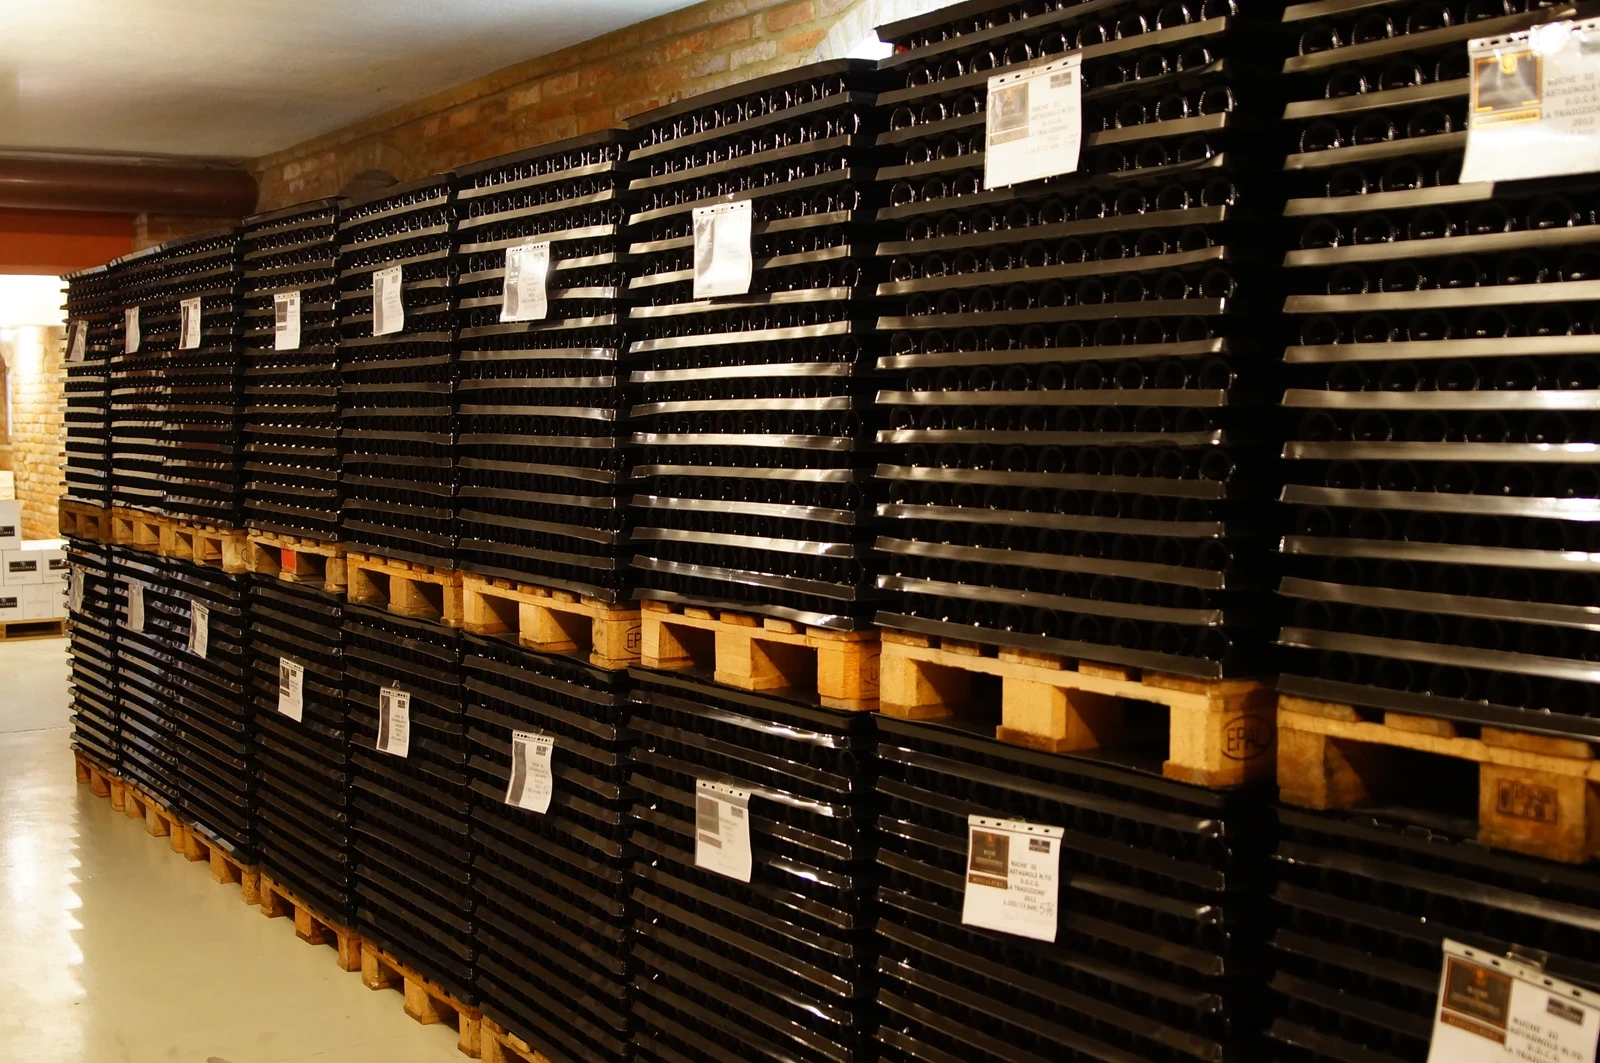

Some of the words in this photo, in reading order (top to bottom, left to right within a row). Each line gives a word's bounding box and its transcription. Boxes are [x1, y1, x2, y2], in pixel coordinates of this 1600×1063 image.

[1584, 72, 1595, 81] DI
[1572, 116, 1594, 127] 2012
[627, 632, 642, 649] EP
[1227, 726, 1265, 752] EPAL
[1009, 868, 1038, 879] ASTAGNOLE
[1509, 1027, 1558, 1051] ASTAGNOLE
